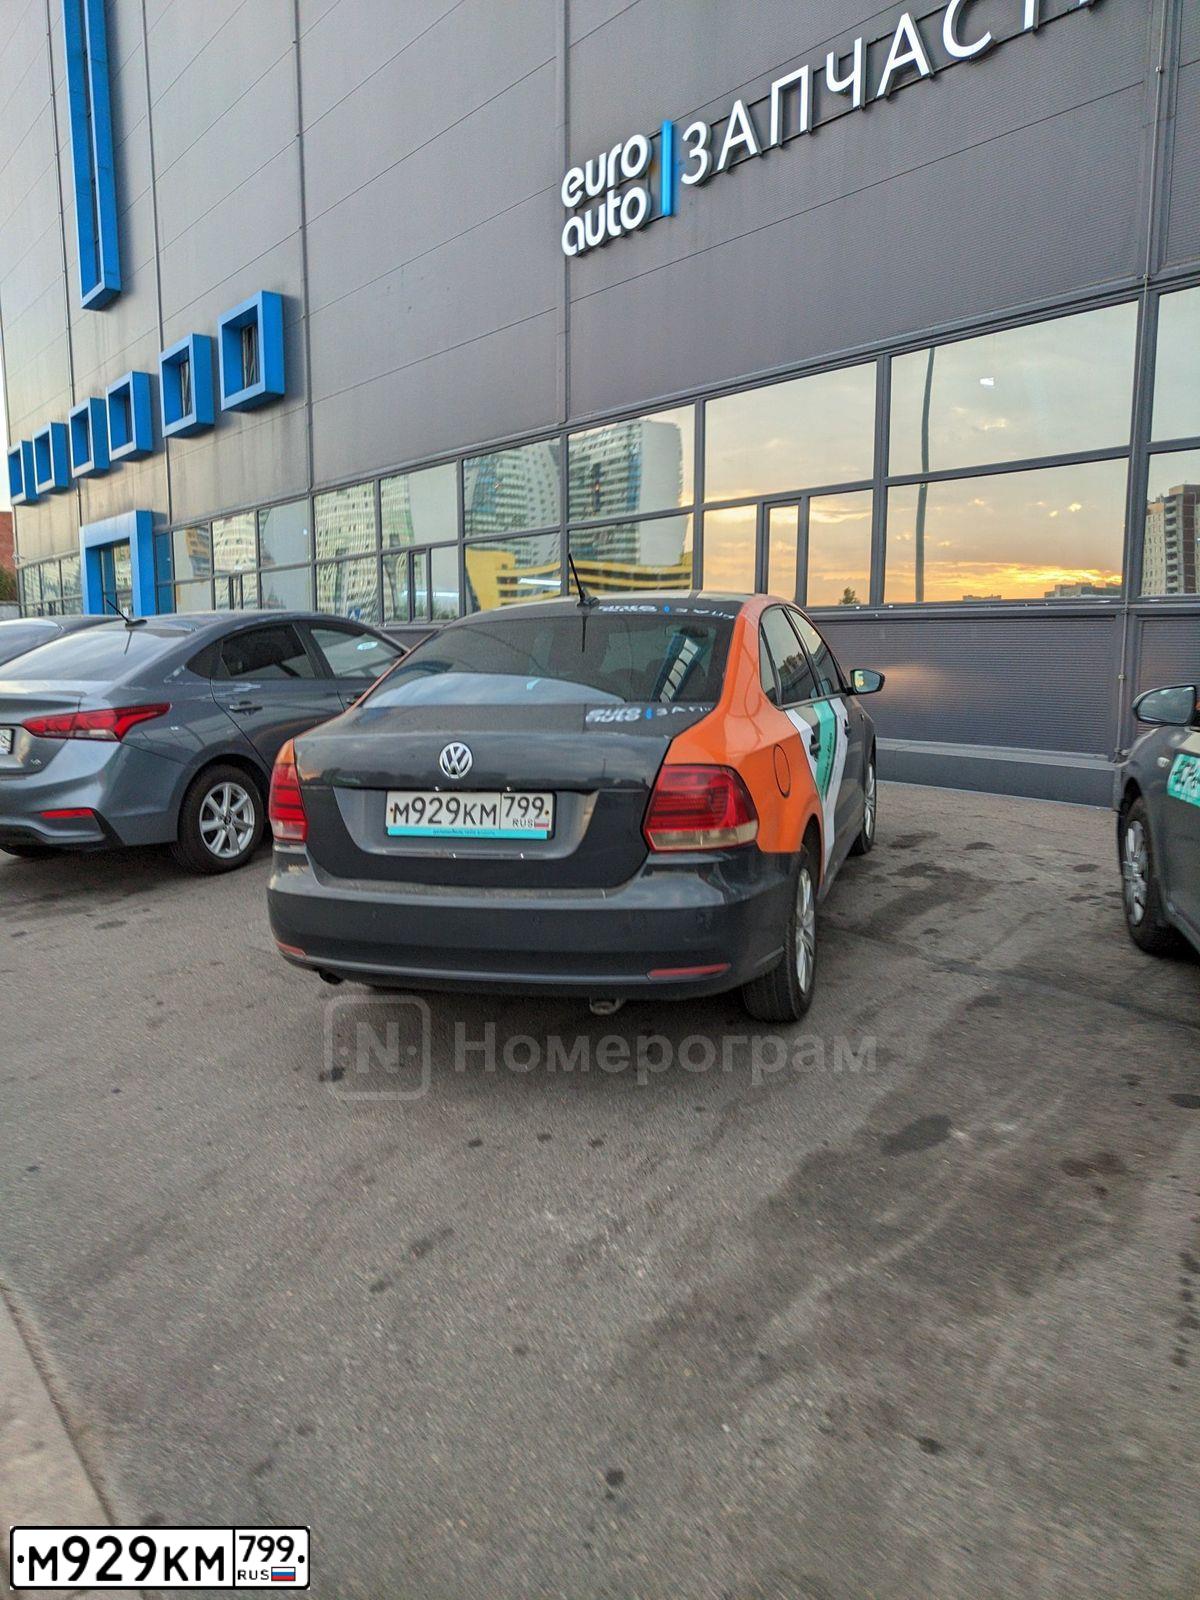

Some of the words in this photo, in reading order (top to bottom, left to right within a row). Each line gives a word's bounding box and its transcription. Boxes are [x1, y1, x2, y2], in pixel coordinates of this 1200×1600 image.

[681, 0, 1087, 186] ЗАПЧАС
[561, 134, 649, 208] euro
[561, 187, 648, 256] auto
[503, 796, 545, 818] 799
[512, 818, 533, 828] RUS
